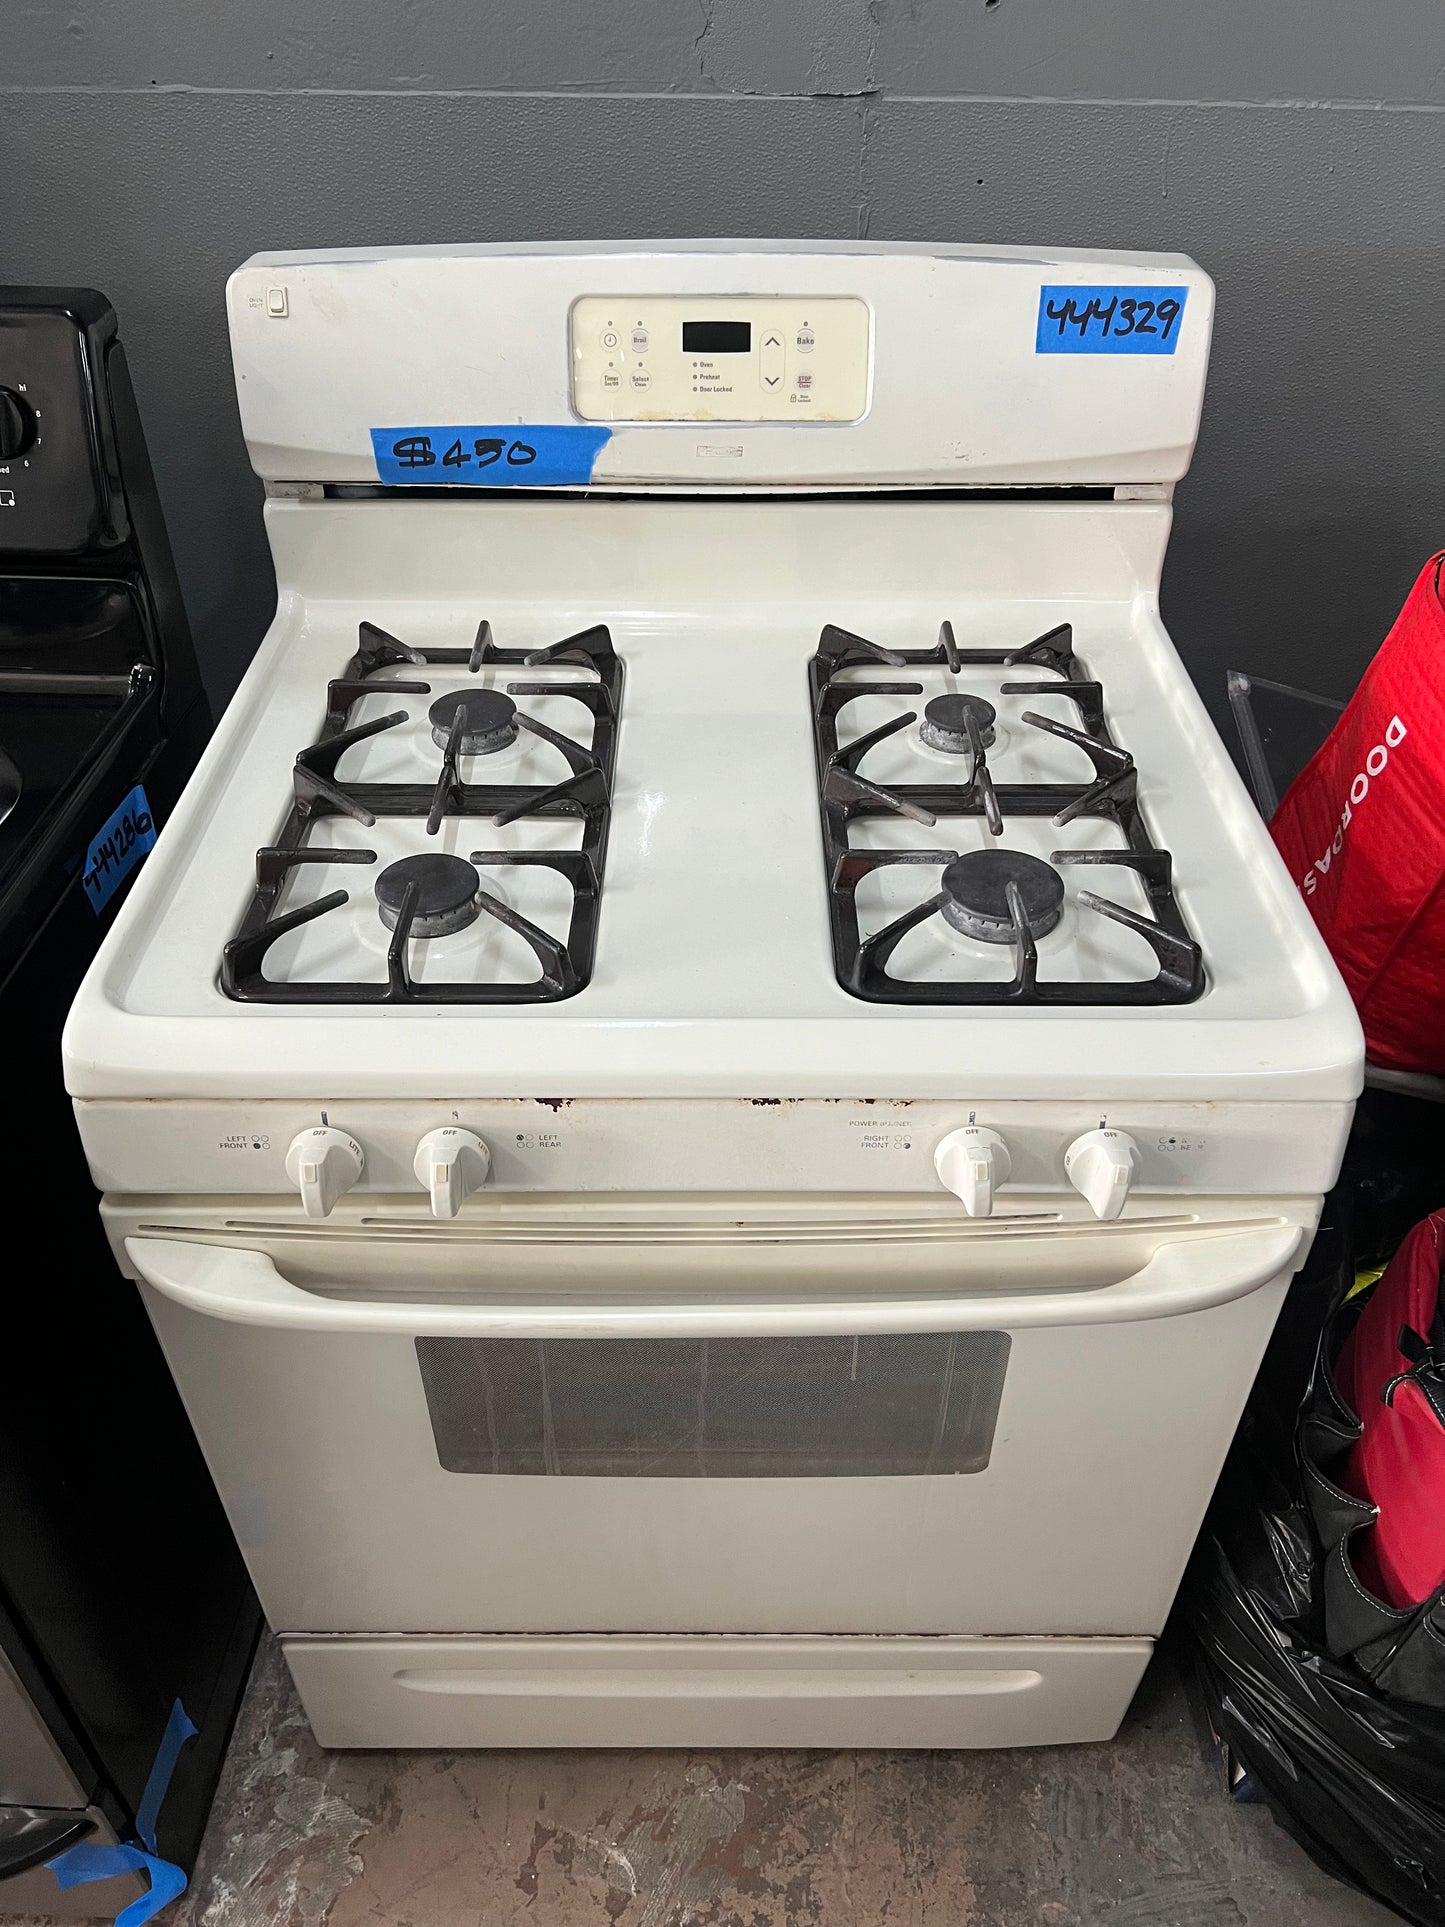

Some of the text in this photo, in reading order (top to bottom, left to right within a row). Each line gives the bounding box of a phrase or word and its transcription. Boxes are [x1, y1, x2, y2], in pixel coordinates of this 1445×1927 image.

[1046, 295, 1181, 340] 444329
[796, 336, 815, 345] Bake
[35, 410, 41, 418] 8
[392, 436, 537, 469] $450
[24, 459, 30, 468] 6
[1297, 715, 1408, 895] DOORDAS
